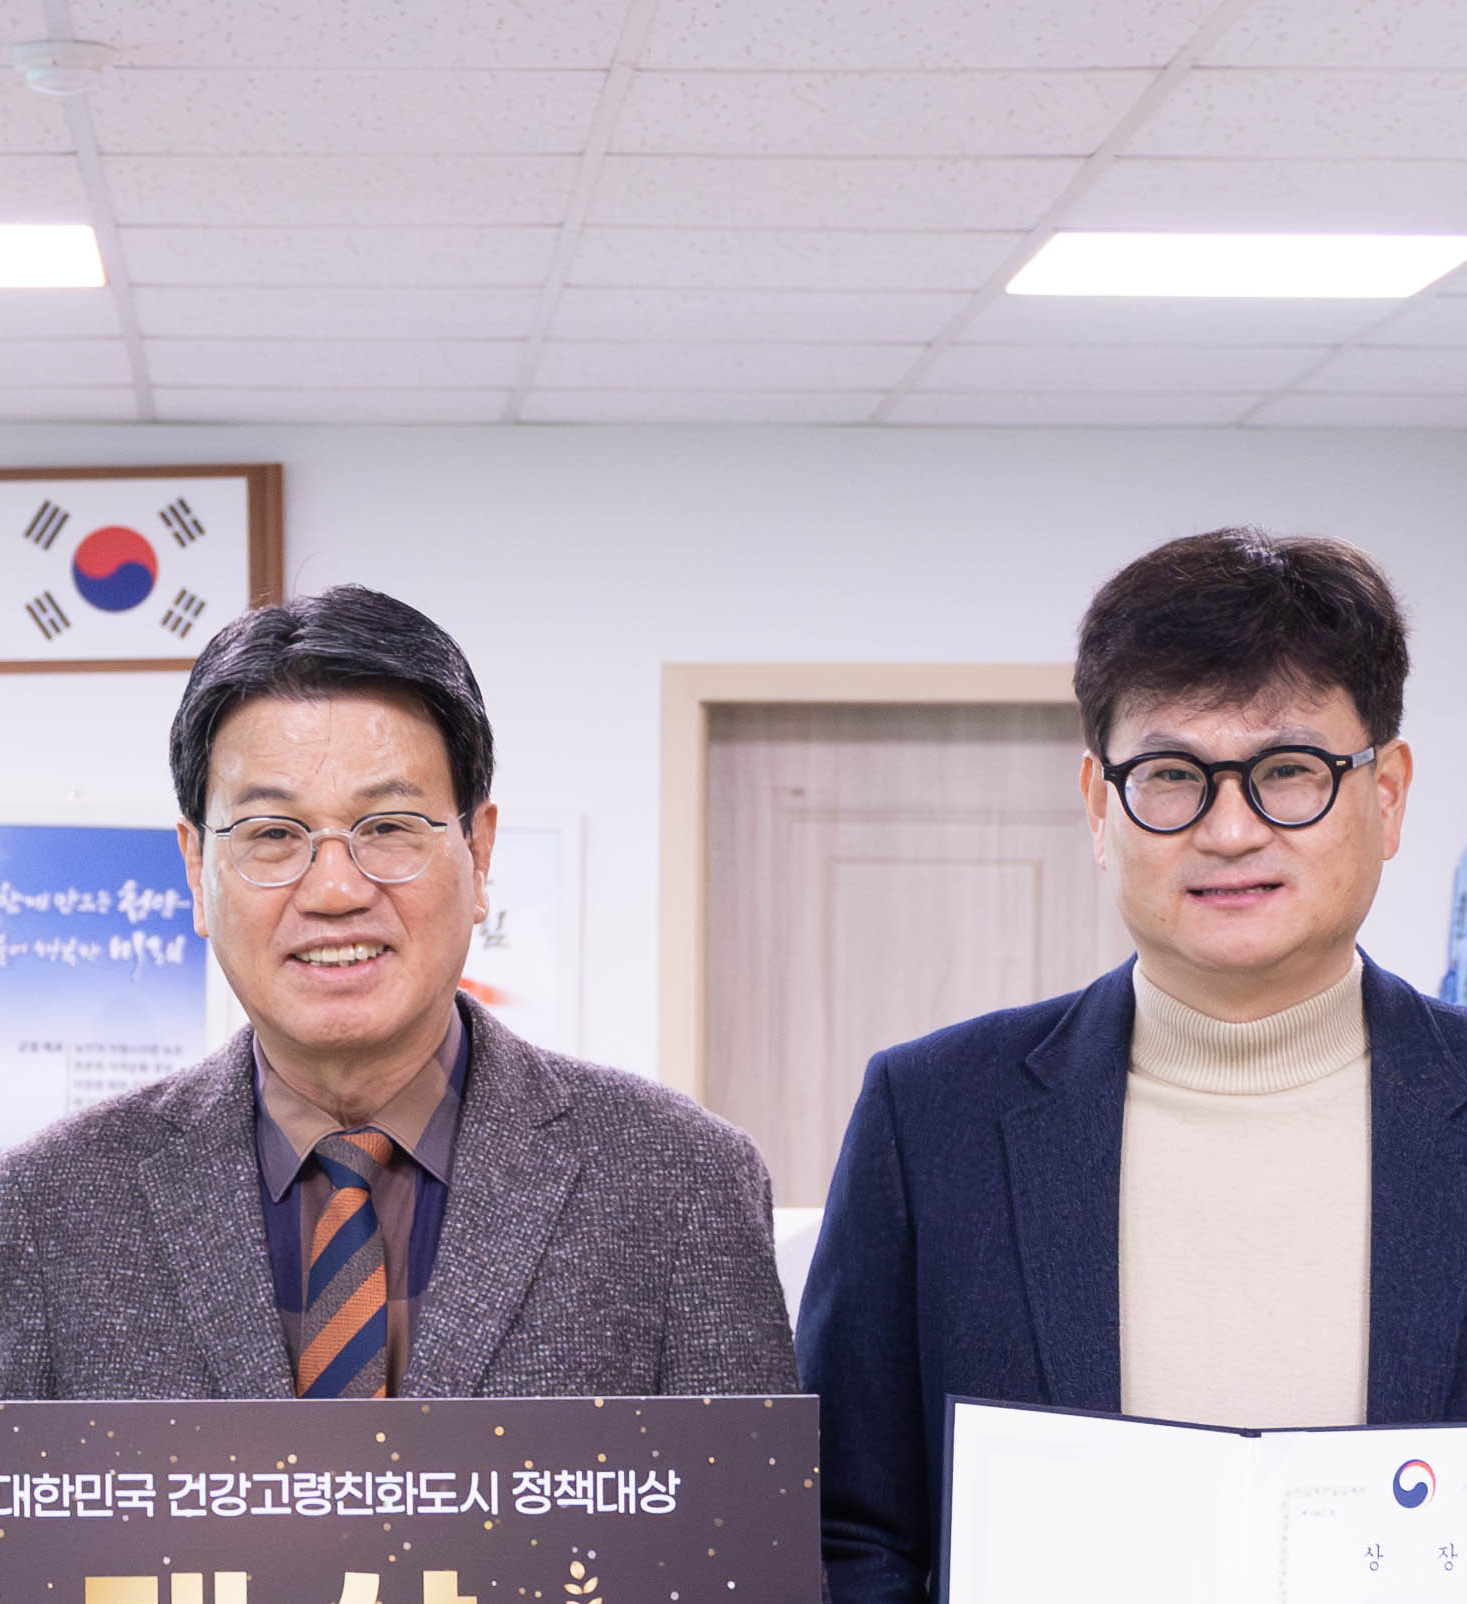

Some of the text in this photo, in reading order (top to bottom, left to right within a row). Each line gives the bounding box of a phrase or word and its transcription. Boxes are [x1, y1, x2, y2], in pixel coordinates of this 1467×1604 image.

[168, 1474, 500, 1519] 건강고령친화도시
[512, 1472, 679, 1517] 정책대상
[1365, 1542, 1458, 1571] 상 장
